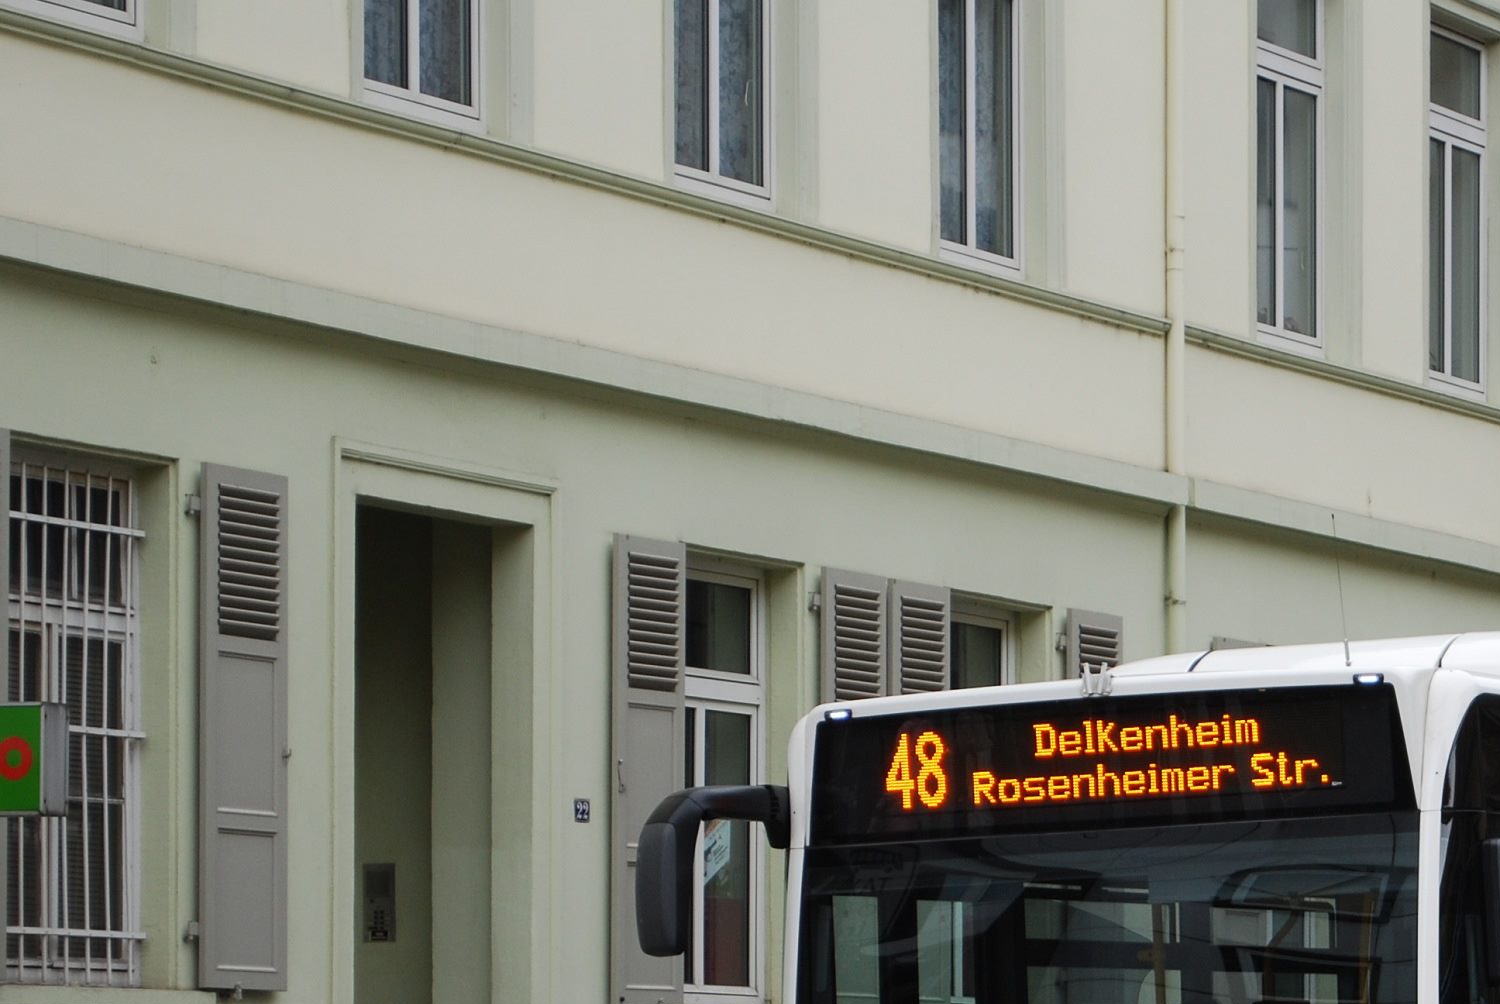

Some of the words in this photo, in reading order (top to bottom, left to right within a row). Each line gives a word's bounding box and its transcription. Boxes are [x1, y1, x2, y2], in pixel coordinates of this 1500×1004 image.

[884, 730, 948, 810] 48
[972, 764, 1236, 806] Rosenheimer
[1250, 751, 1331, 788] Str.
[575, 801, 590, 821] 22
